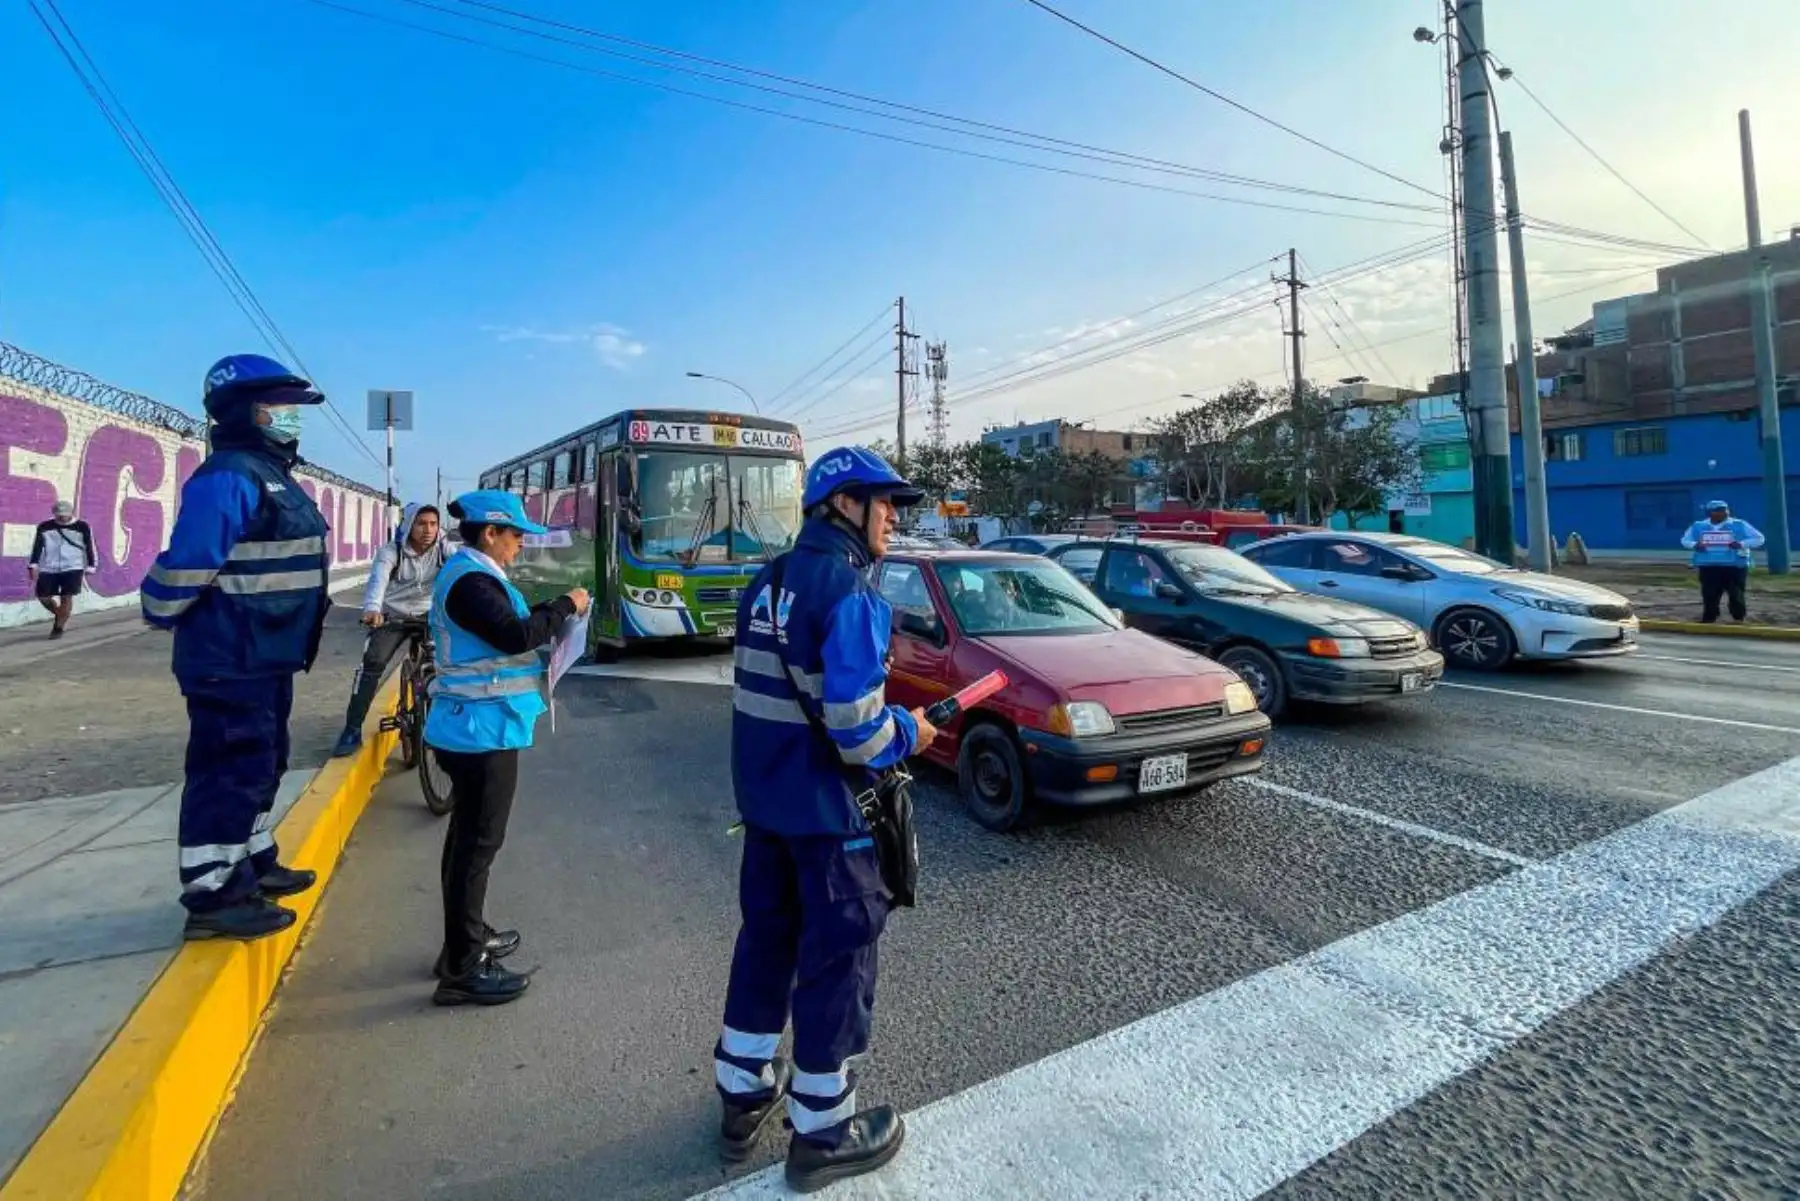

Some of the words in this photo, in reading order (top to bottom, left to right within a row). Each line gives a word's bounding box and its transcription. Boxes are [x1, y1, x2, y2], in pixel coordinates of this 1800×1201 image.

[631, 420, 649, 443] 89
[654, 424, 700, 442] ATE
[741, 431, 792, 449] CALLAO
